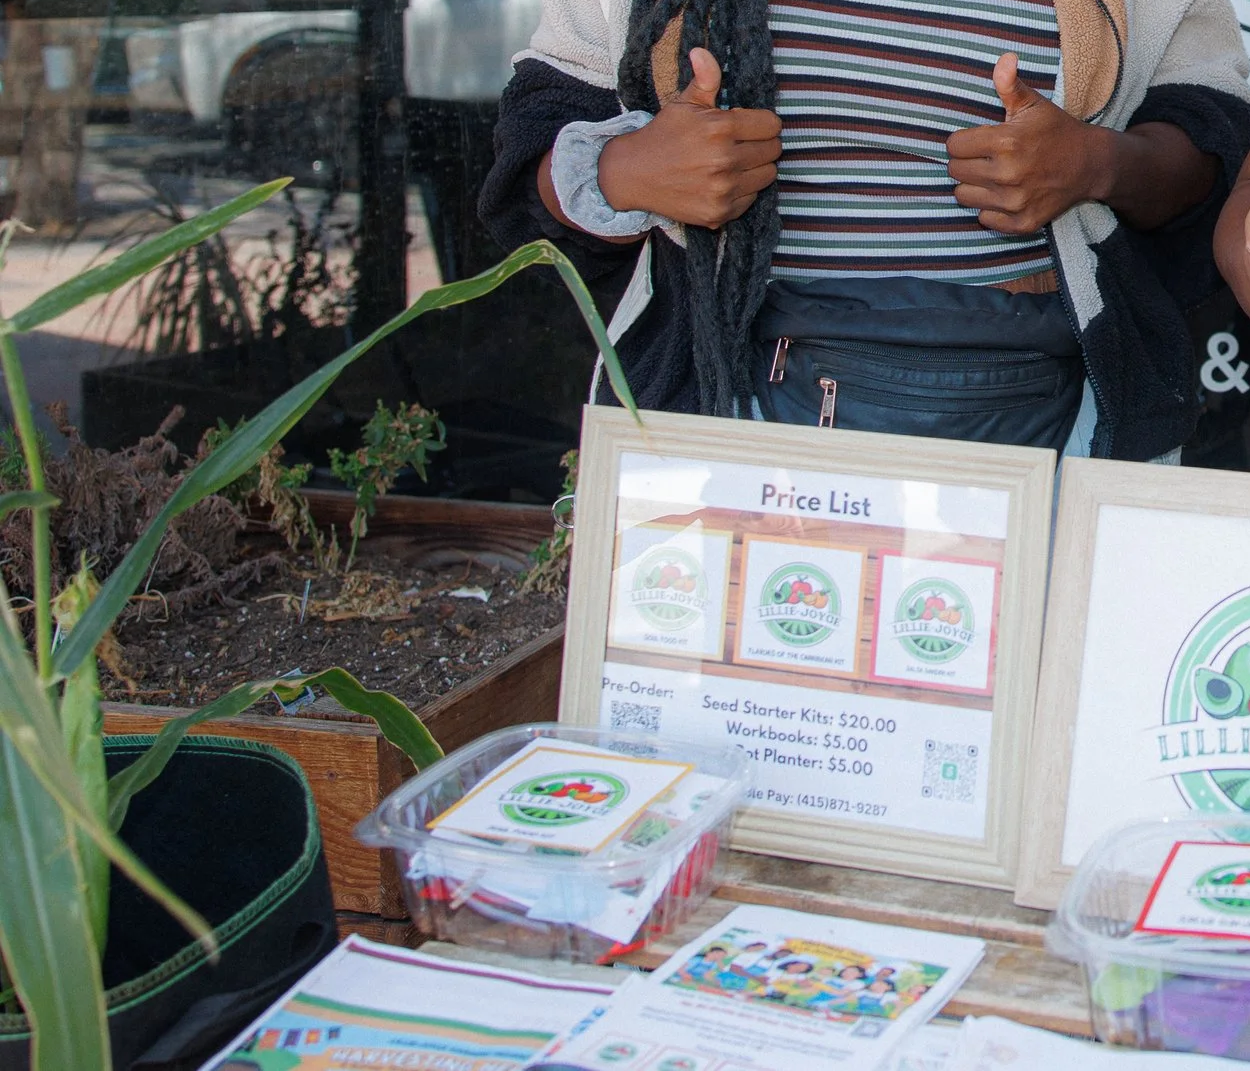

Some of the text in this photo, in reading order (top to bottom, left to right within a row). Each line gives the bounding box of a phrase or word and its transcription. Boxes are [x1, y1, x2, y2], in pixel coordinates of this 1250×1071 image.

[1199, 331, 1250, 395] &
[761, 483, 872, 518] Price List
[758, 605, 841, 628] LILLIE-JOYCE
[893, 621, 975, 644] LILLIE-JOYCE
[601, 676, 674, 699] Pre-Order:
[702, 694, 897, 734] Seed Starter Kits: $20.00
[726, 719, 868, 753] Workbooks: $5.00
[736, 743, 873, 776] ot Planter: $5.00
[766, 788, 794, 806] Pay:
[796, 792, 888, 818] (415)871-9287
